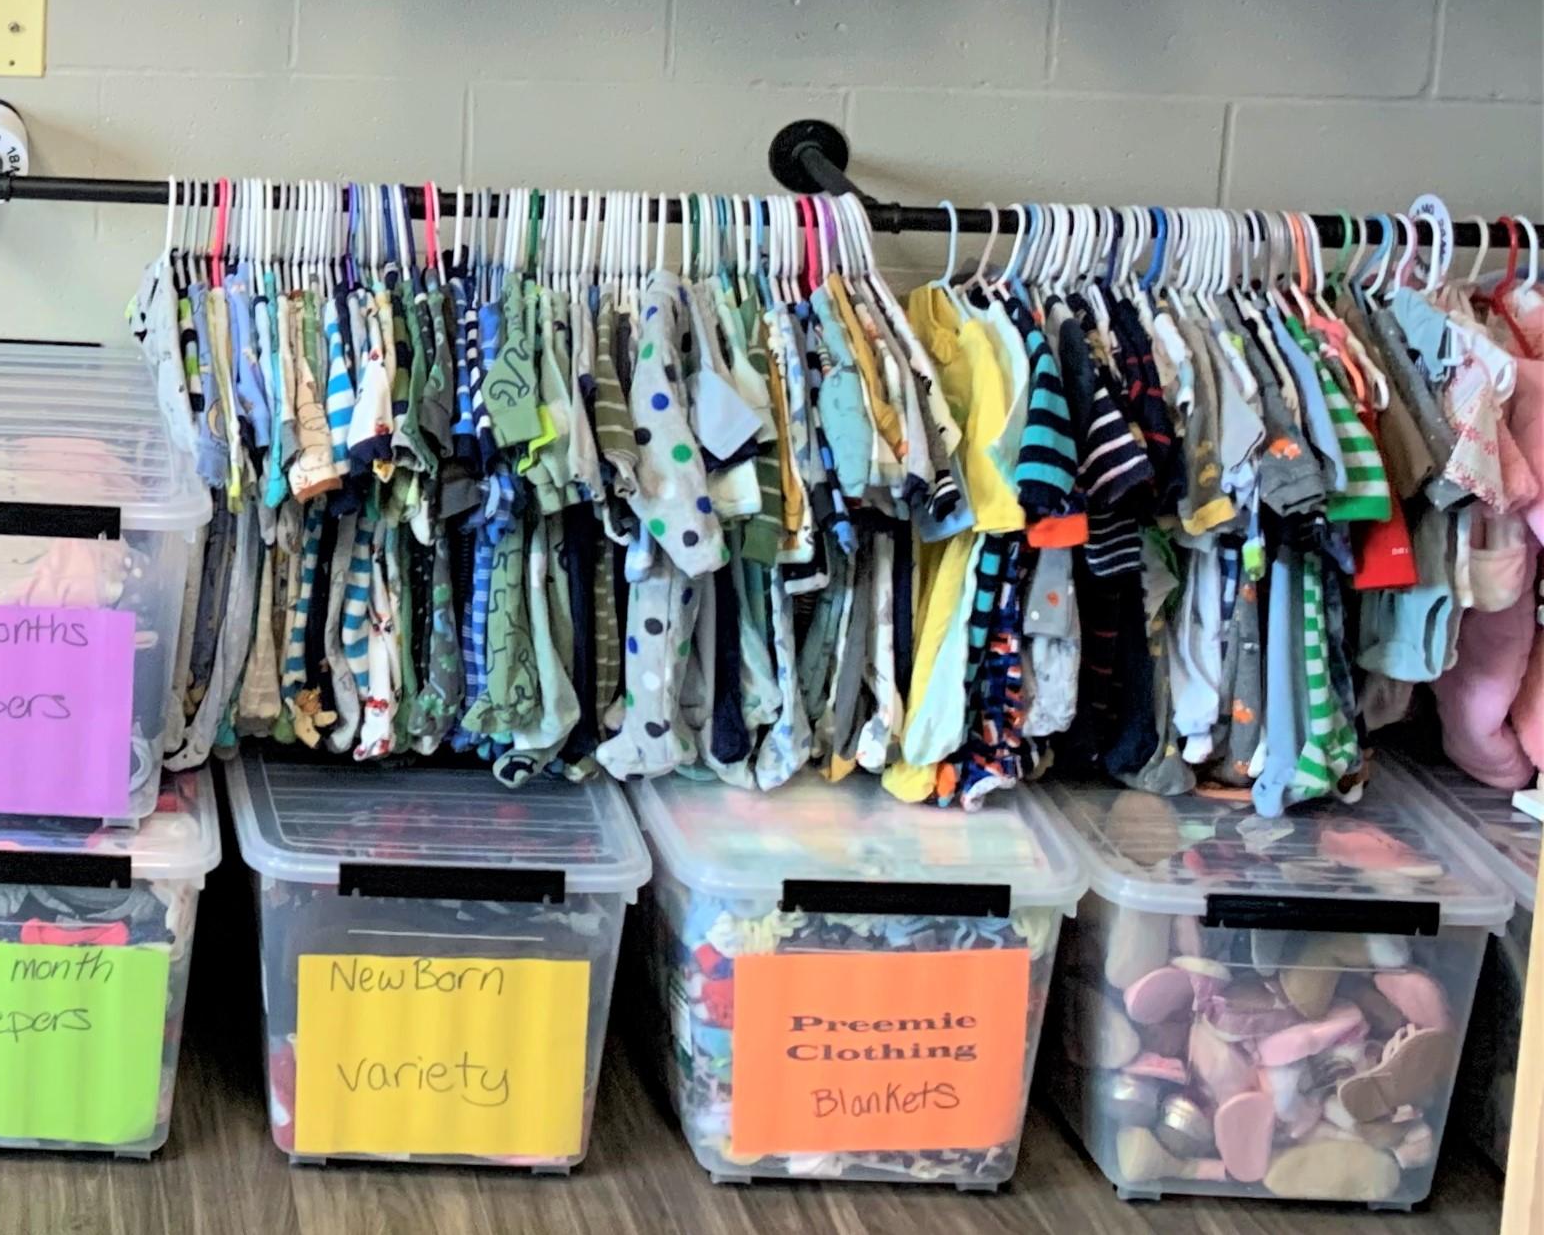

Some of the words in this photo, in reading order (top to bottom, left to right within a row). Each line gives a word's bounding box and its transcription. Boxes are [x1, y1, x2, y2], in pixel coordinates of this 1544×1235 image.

[10, 949, 114, 983] month
[788, 1012, 977, 1032] Preemie
[786, 1043, 978, 1062] Clothing
